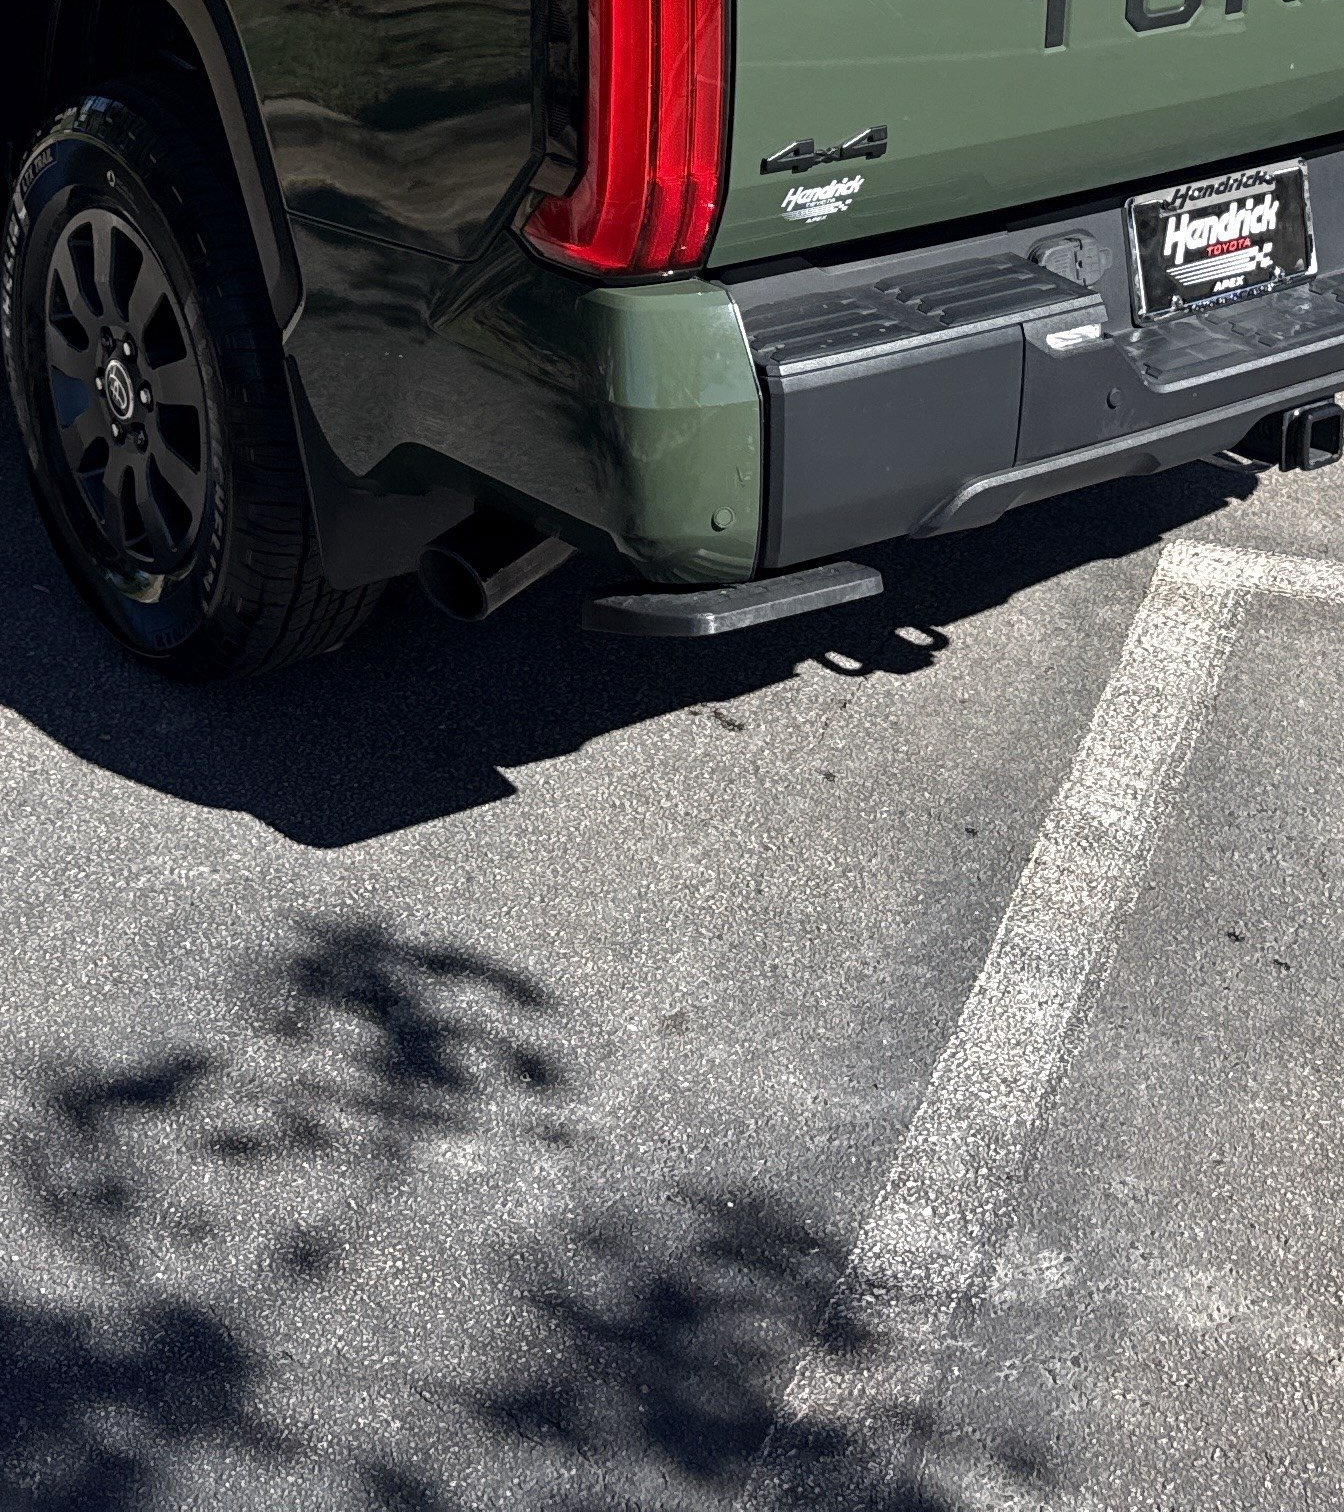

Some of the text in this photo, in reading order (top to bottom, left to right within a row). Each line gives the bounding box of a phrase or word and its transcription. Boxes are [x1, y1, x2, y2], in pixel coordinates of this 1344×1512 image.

[780, 174, 865, 211] Hendrick
[1162, 170, 1276, 210] Hendrick
[1163, 192, 1280, 264] Hendrick
[1206, 237, 1252, 257] TOYOTA
[1212, 275, 1246, 294] APEX
